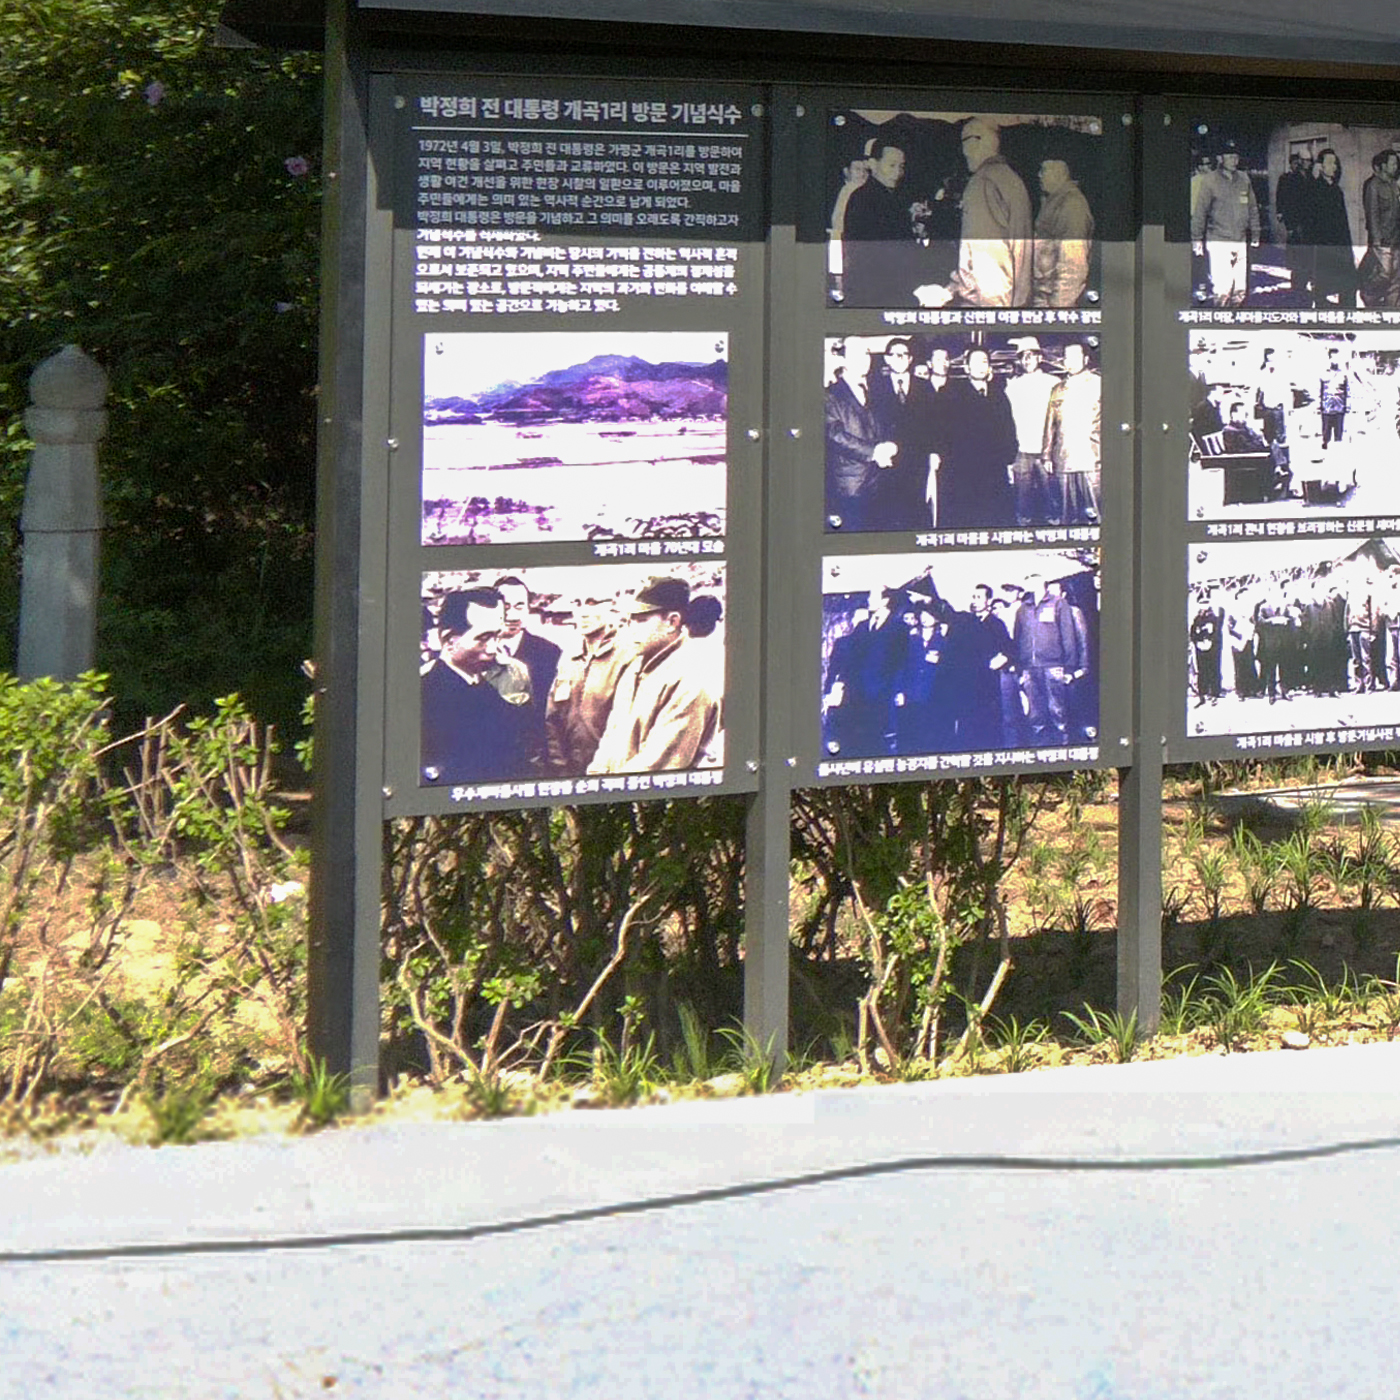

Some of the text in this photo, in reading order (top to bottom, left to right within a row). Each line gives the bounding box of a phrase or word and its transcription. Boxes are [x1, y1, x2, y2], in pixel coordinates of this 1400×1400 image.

[420, 96, 742, 124] 박정희 전 대통령 개곡1리 방문 기념식수
